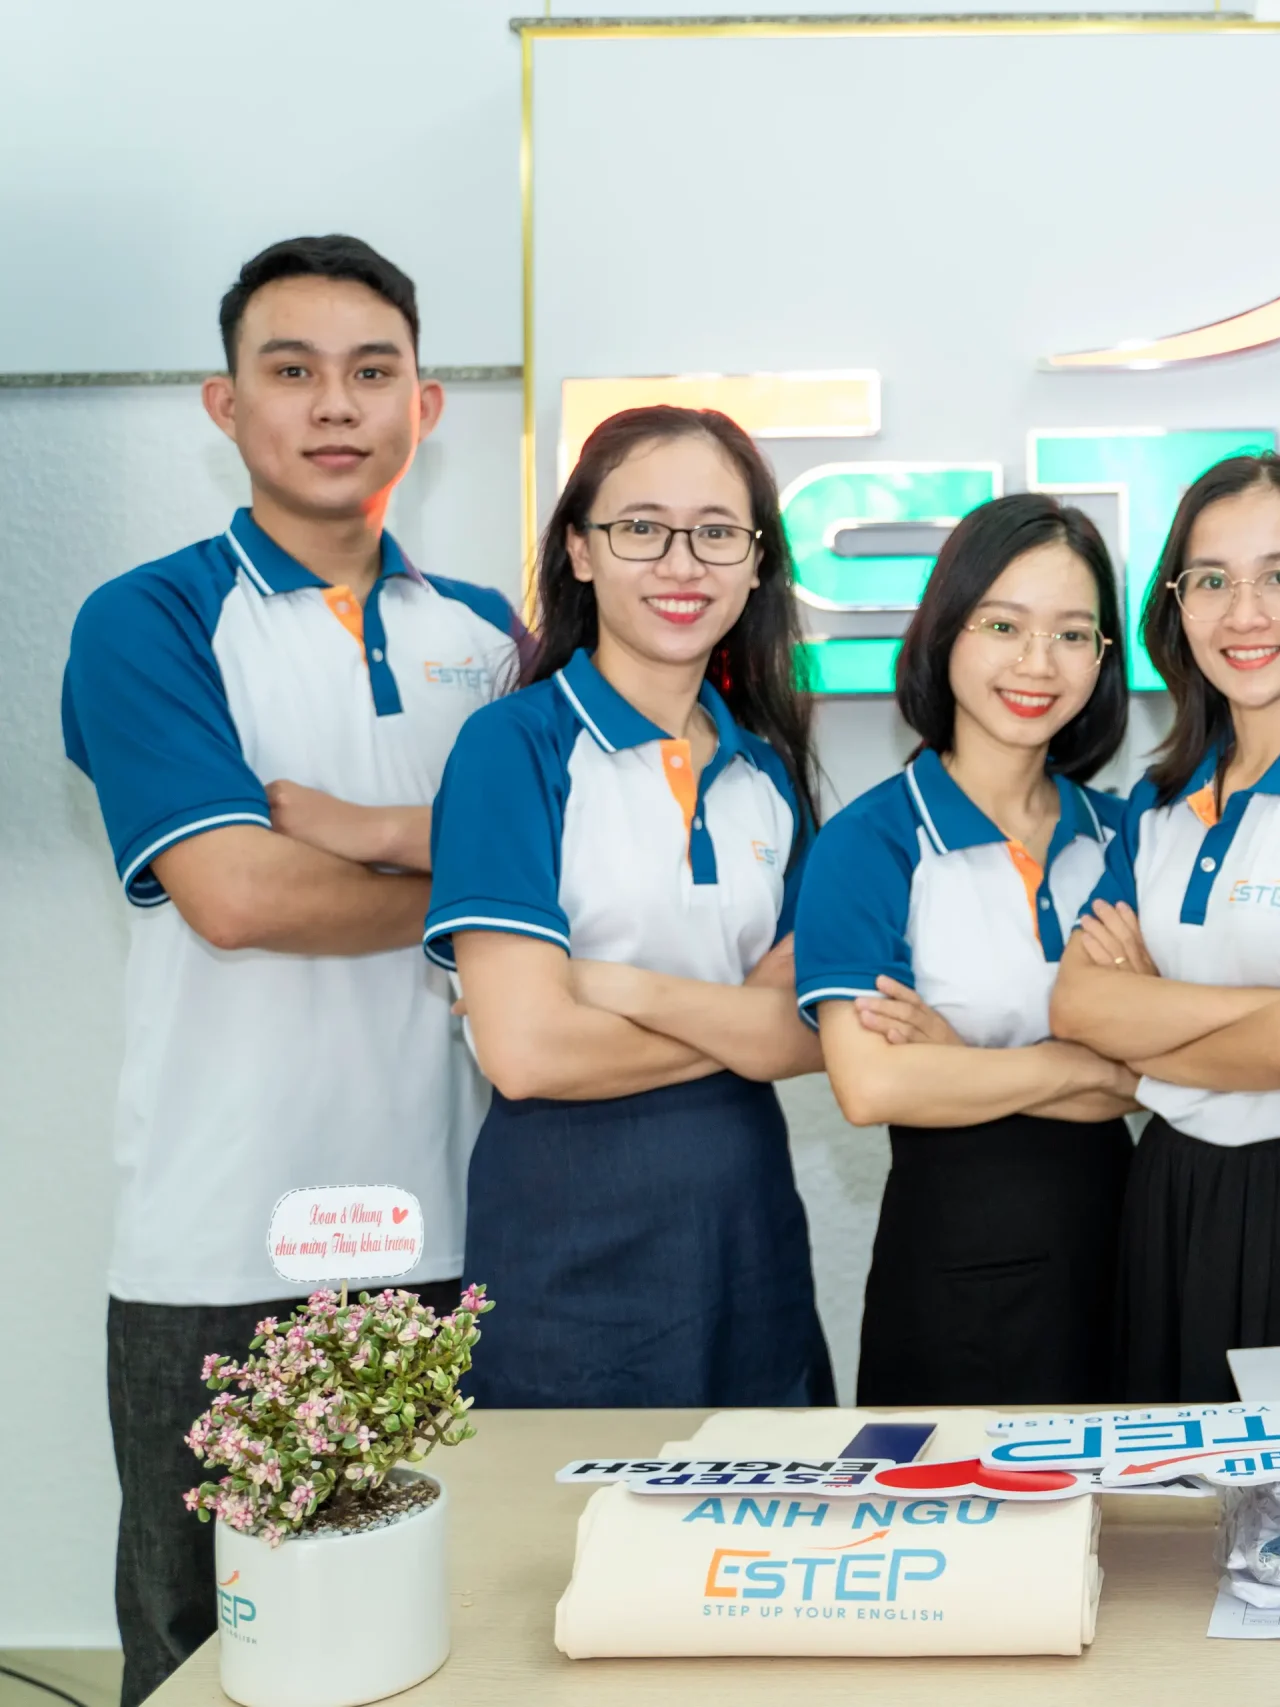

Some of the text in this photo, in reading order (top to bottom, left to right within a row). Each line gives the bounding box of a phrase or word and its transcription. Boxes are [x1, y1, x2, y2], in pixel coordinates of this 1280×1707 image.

[360, 1232, 382, 1253] khai
[1177, 1405, 1271, 1417] YOUR
[997, 1413, 1152, 1429] ENGLISH
[572, 1461, 879, 1474] ENGLISH
[646, 1472, 869, 1486] ESTEP
[681, 1497, 830, 1528] ANH
[703, 1548, 947, 1601] ESTEP
[703, 1604, 944, 1622] STEP UP YOUR ENGLISH
